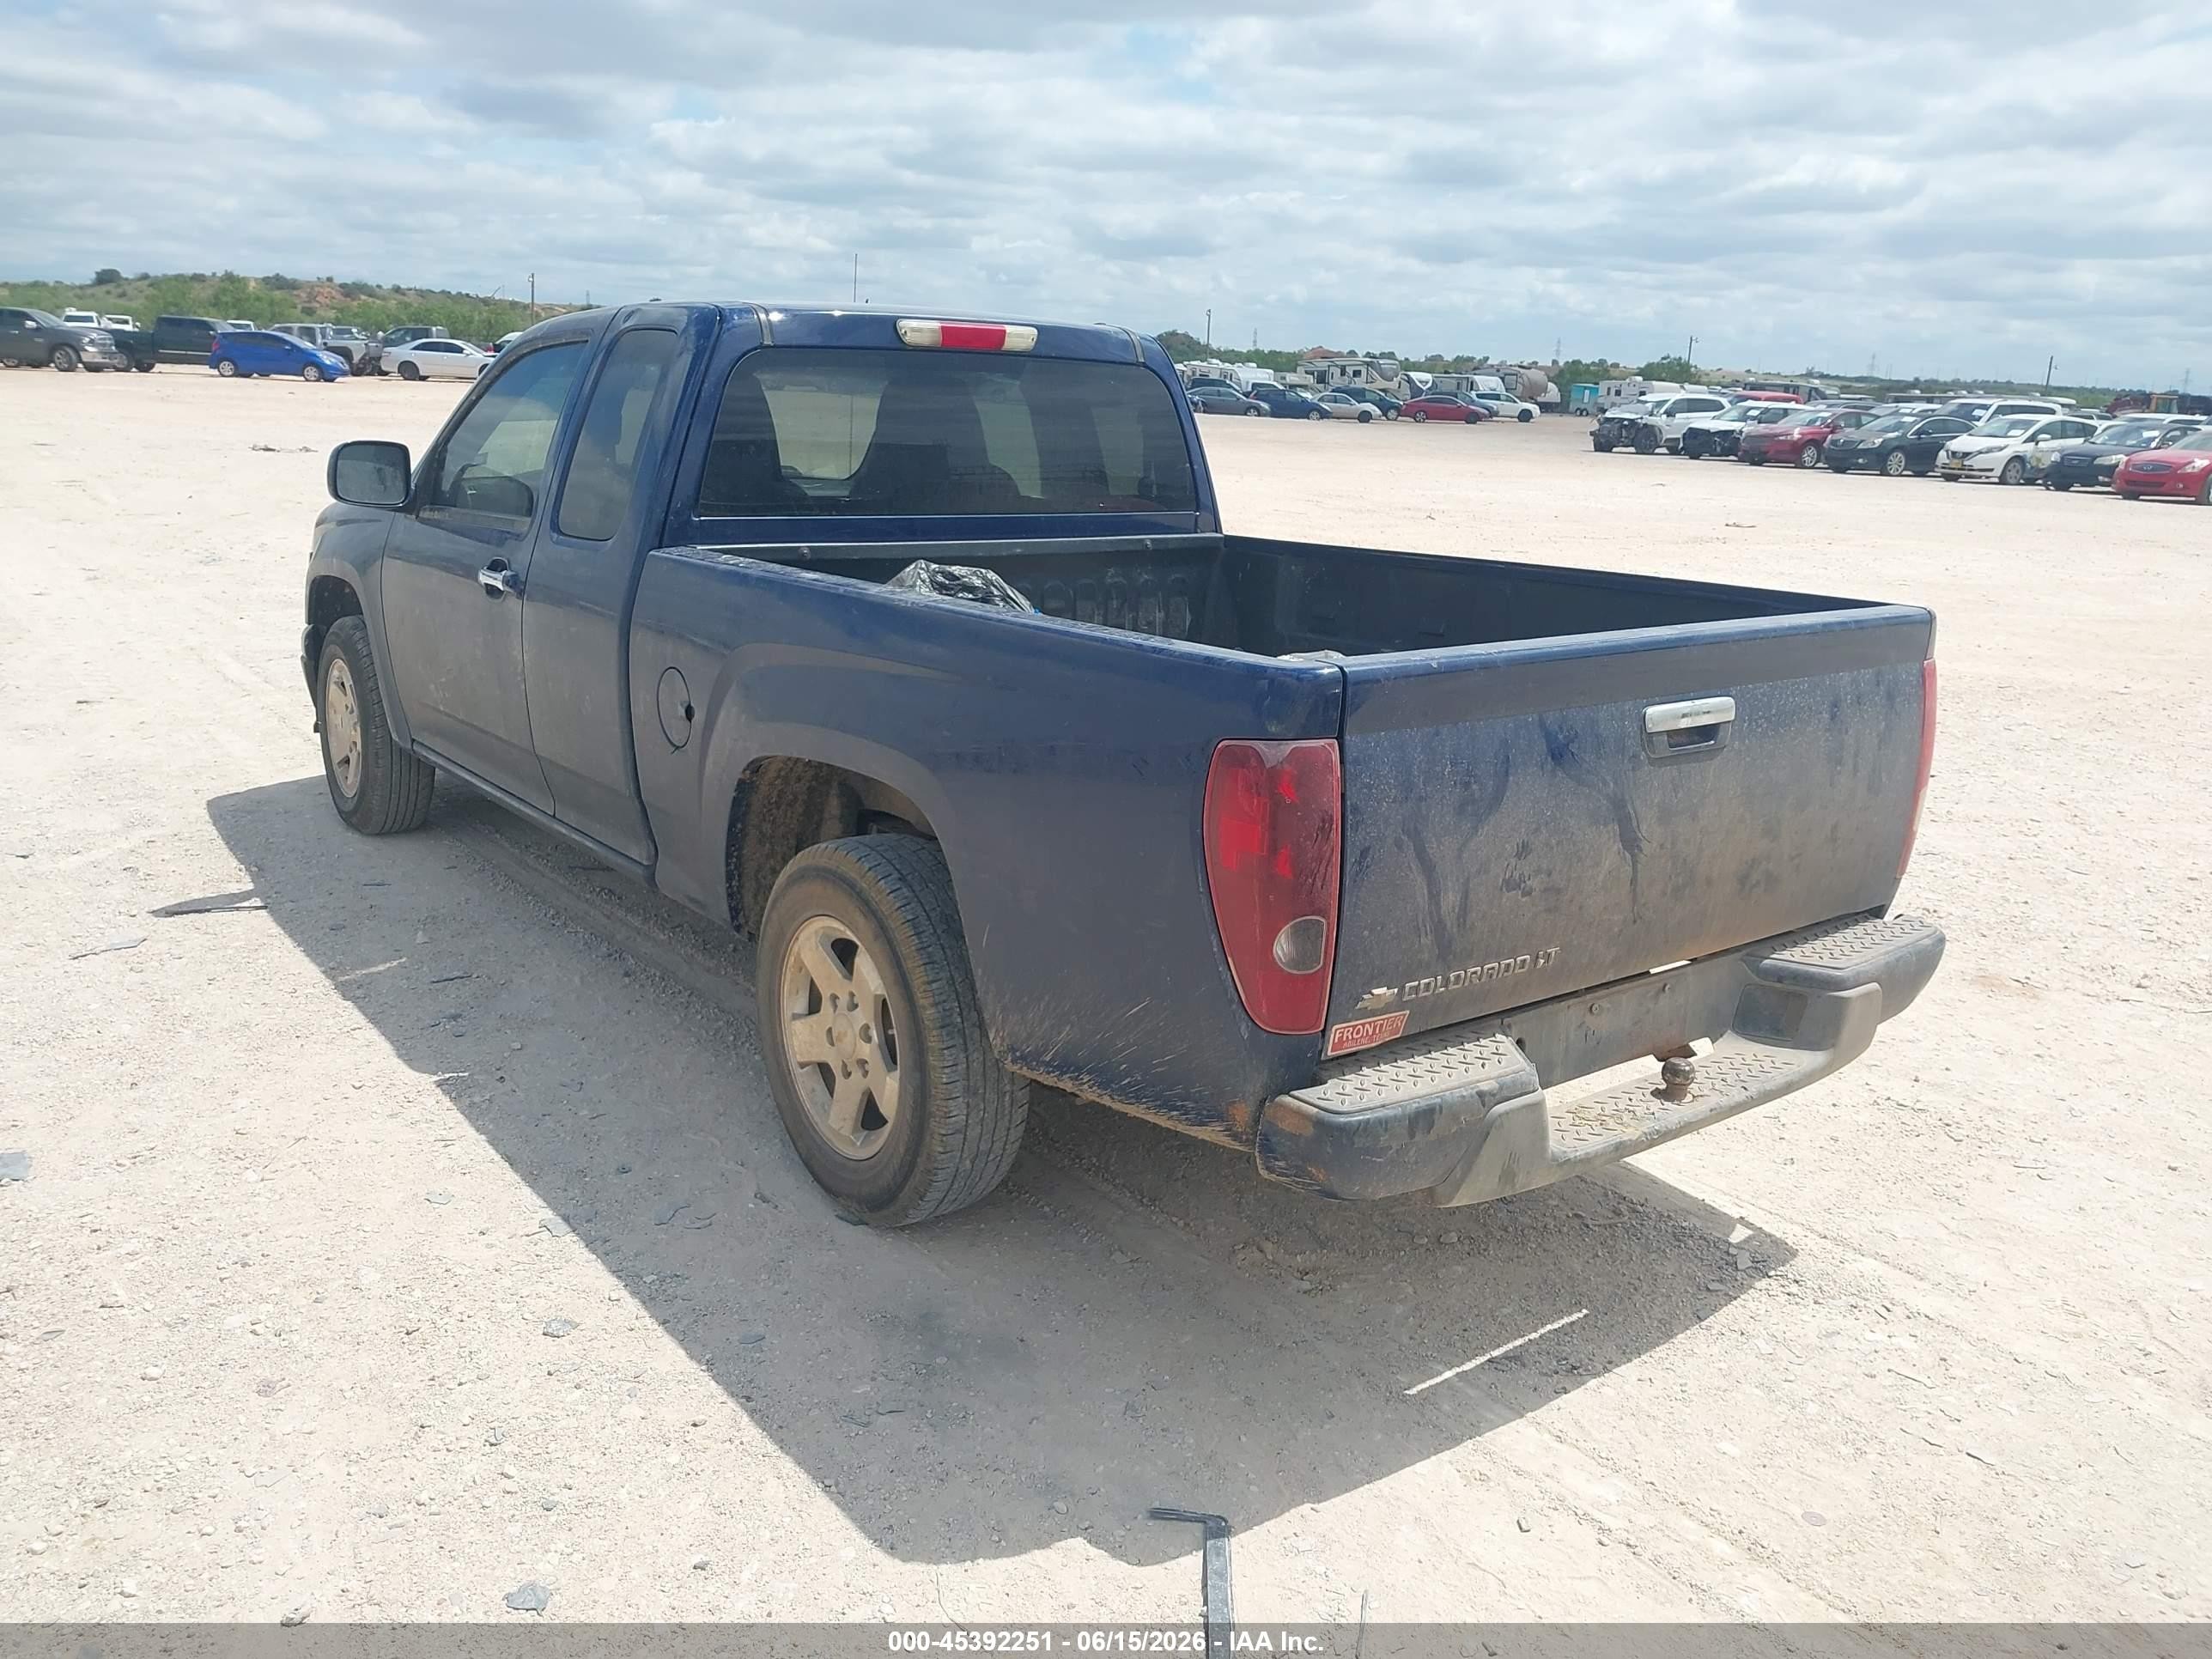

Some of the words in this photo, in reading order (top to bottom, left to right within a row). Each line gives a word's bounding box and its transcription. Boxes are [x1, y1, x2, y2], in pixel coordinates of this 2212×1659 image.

[1401, 954, 1531, 1001] COLORADO
[1534, 946, 1560, 969] LT
[1334, 1015, 1404, 1043] FRONTIER
